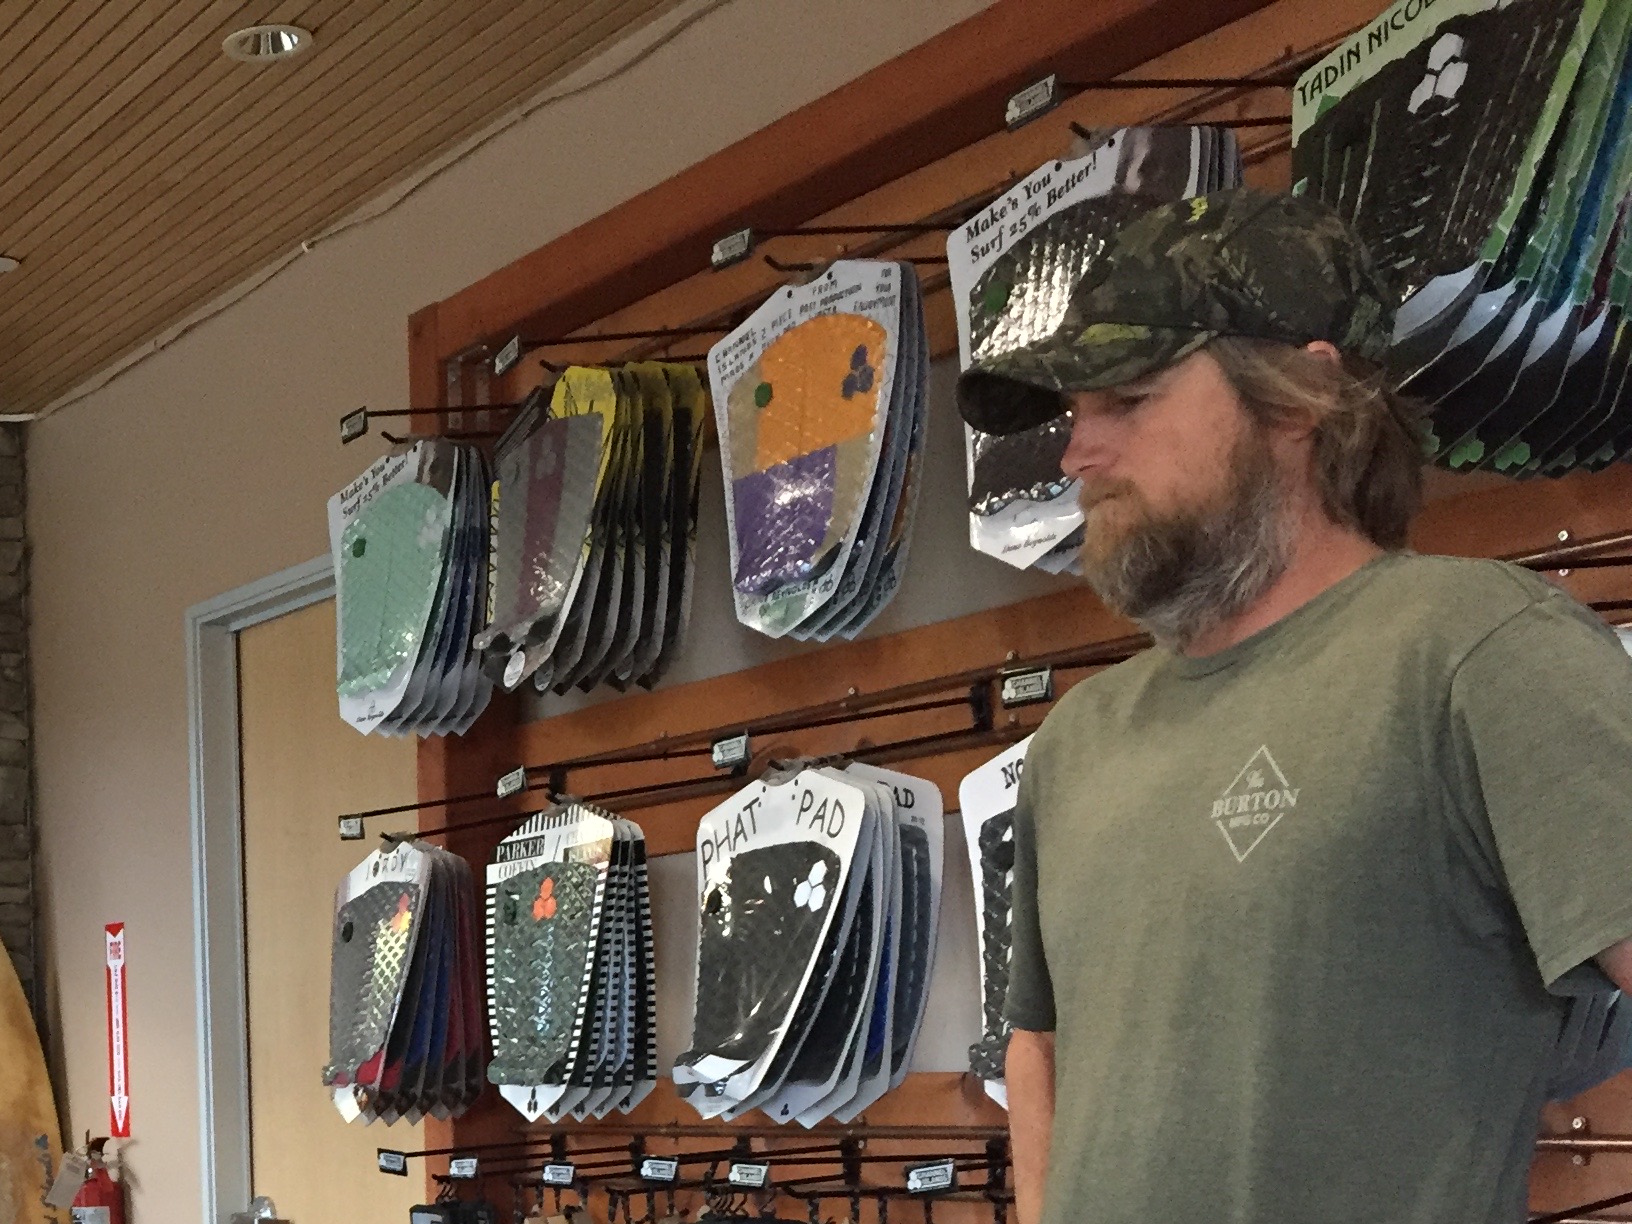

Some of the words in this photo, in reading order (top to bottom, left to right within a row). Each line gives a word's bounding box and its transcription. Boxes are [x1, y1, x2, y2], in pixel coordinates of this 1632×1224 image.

[965, 197, 1018, 243] Make's
[1022, 173, 1052, 200] You
[971, 225, 1005, 264] Surf
[1009, 202, 1041, 237] 25%
[1047, 151, 1097, 209] Better!
[701, 797, 760, 880] PHAT
[796, 789, 846, 838] PAD
[1211, 788, 1301, 818] BURTON
[496, 838, 545, 863] PARKER
